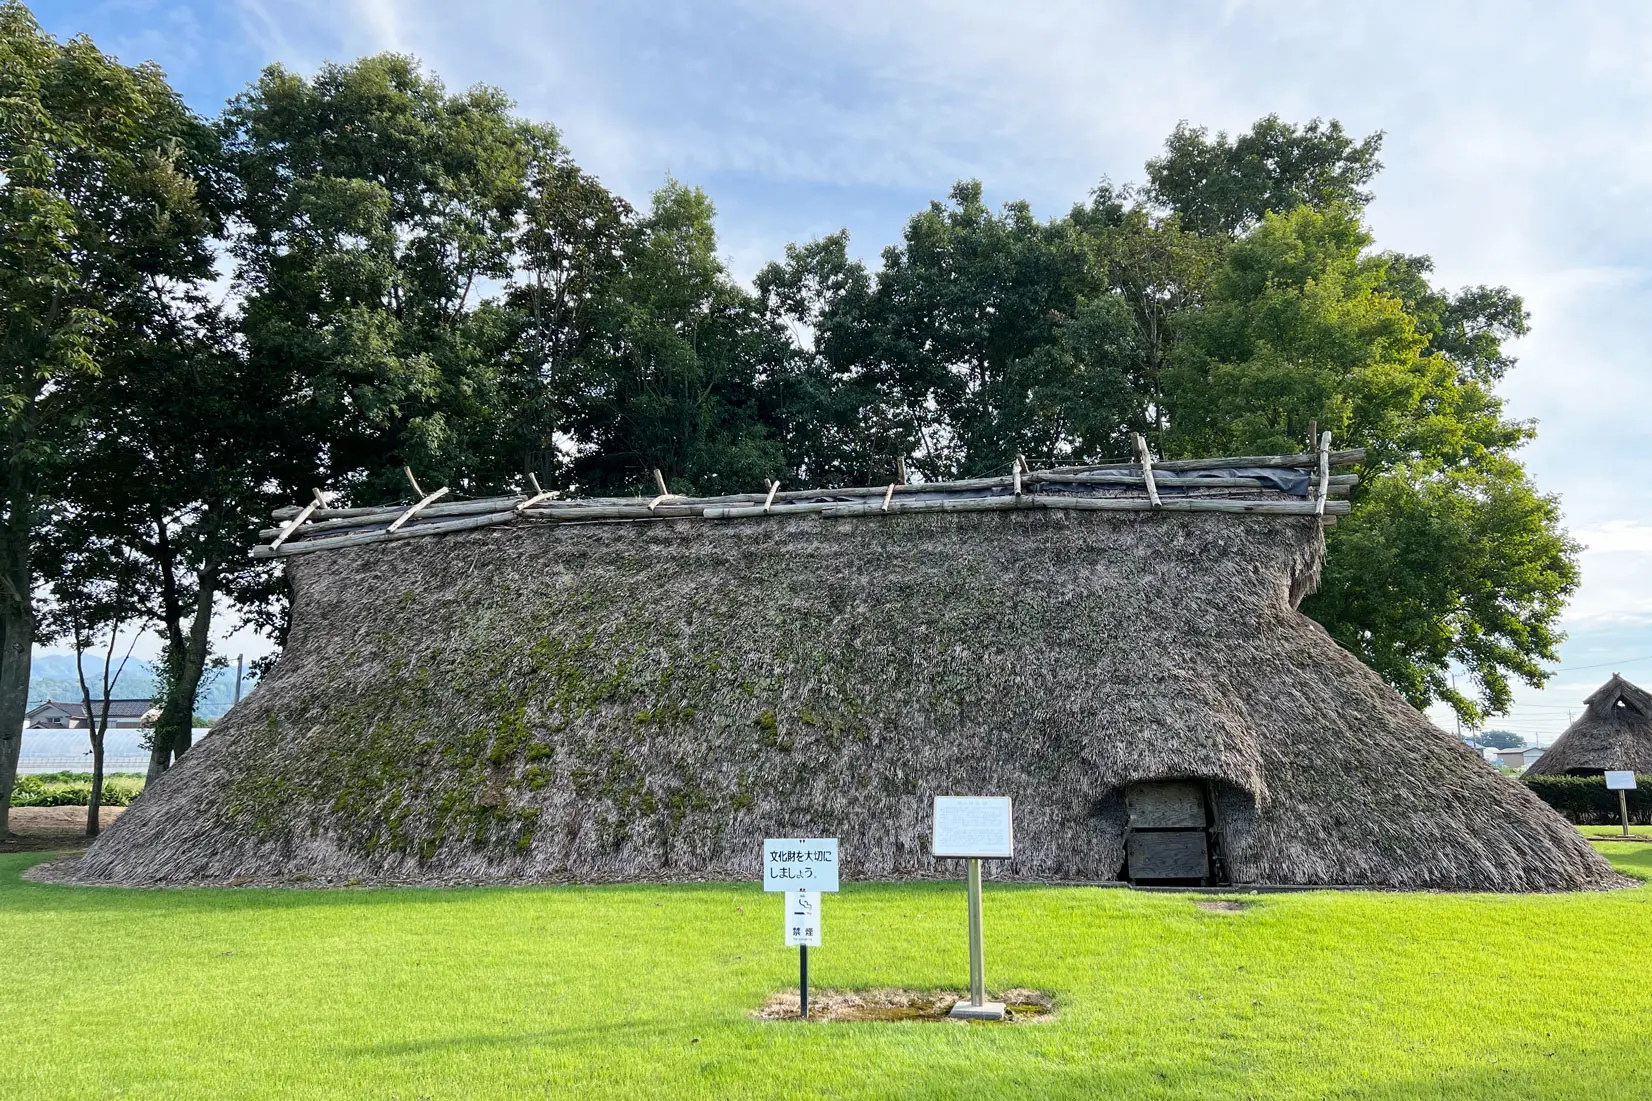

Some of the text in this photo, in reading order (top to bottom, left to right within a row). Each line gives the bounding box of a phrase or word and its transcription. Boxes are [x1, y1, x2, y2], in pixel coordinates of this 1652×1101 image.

[770, 850, 832, 862] 文化財を大切に
[770, 867, 817, 879] しましょう。
